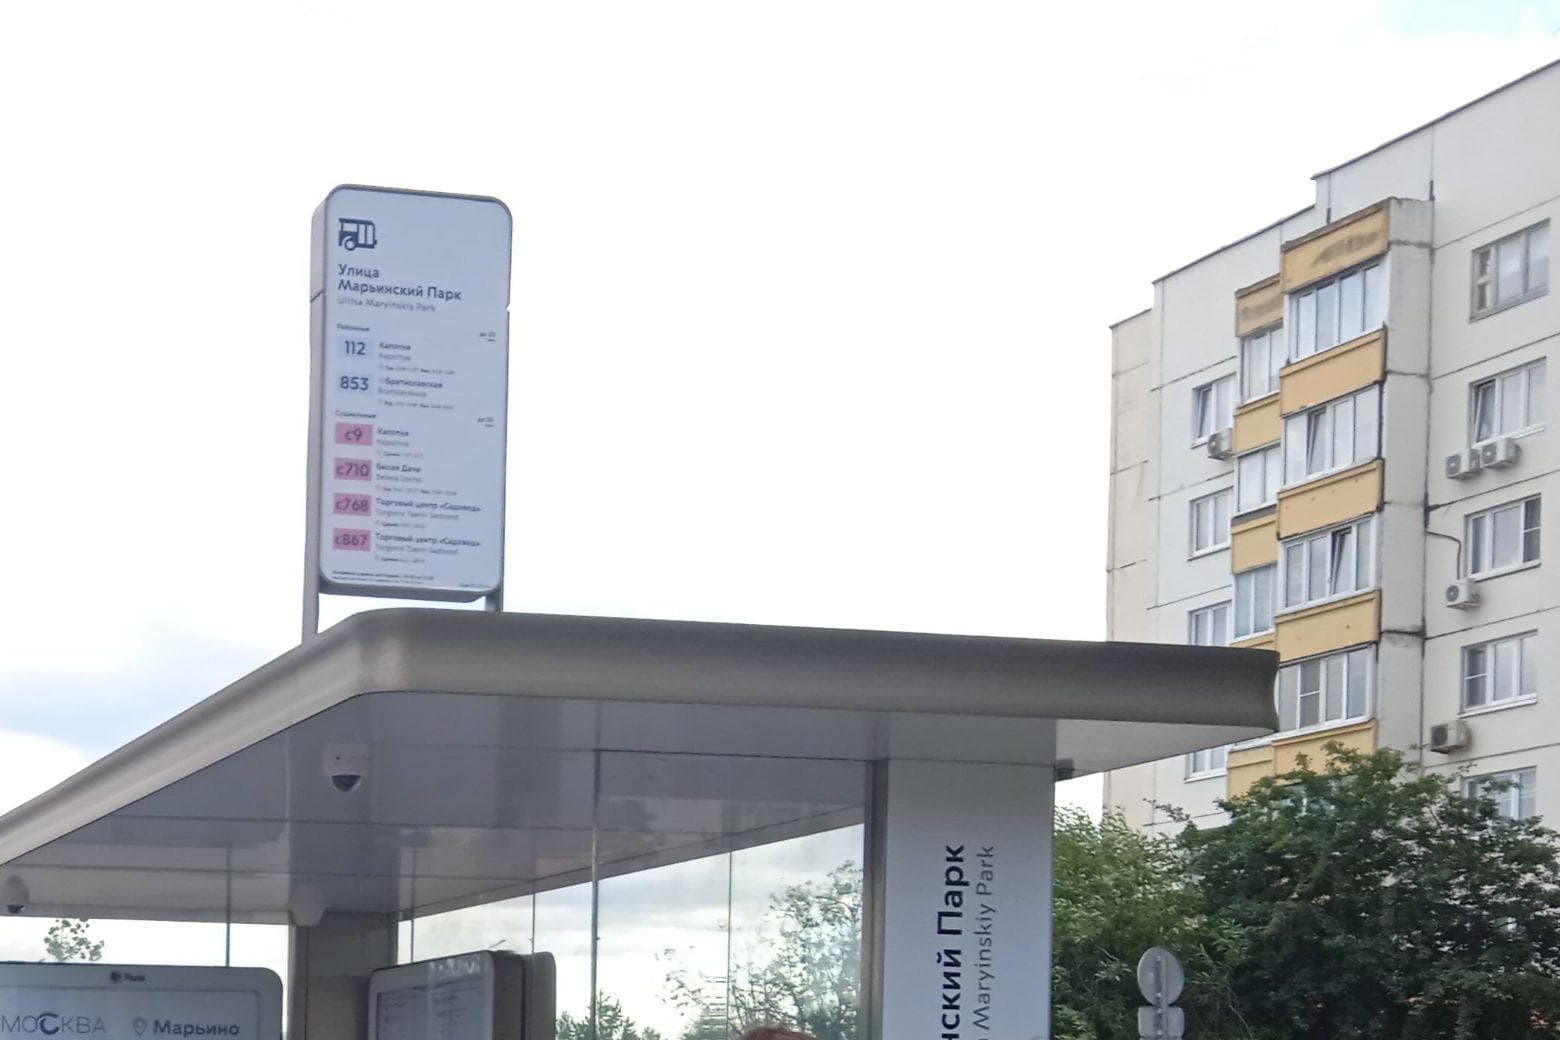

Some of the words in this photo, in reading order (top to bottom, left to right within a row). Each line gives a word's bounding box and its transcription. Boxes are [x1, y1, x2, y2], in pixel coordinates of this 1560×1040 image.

[338, 264, 379, 279] Улица
[338, 279, 424, 297] Марьинский
[427, 286, 461, 302] Парк
[344, 340, 367, 356] 112
[340, 376, 369, 391] 853
[976, 845, 995, 895] Park
[937, 845, 970, 936] Парк
[973, 903, 997, 1030] Maryinskiy
[1, 1012, 107, 1035] МОСКВА
[153, 1020, 240, 1038] Марьино
